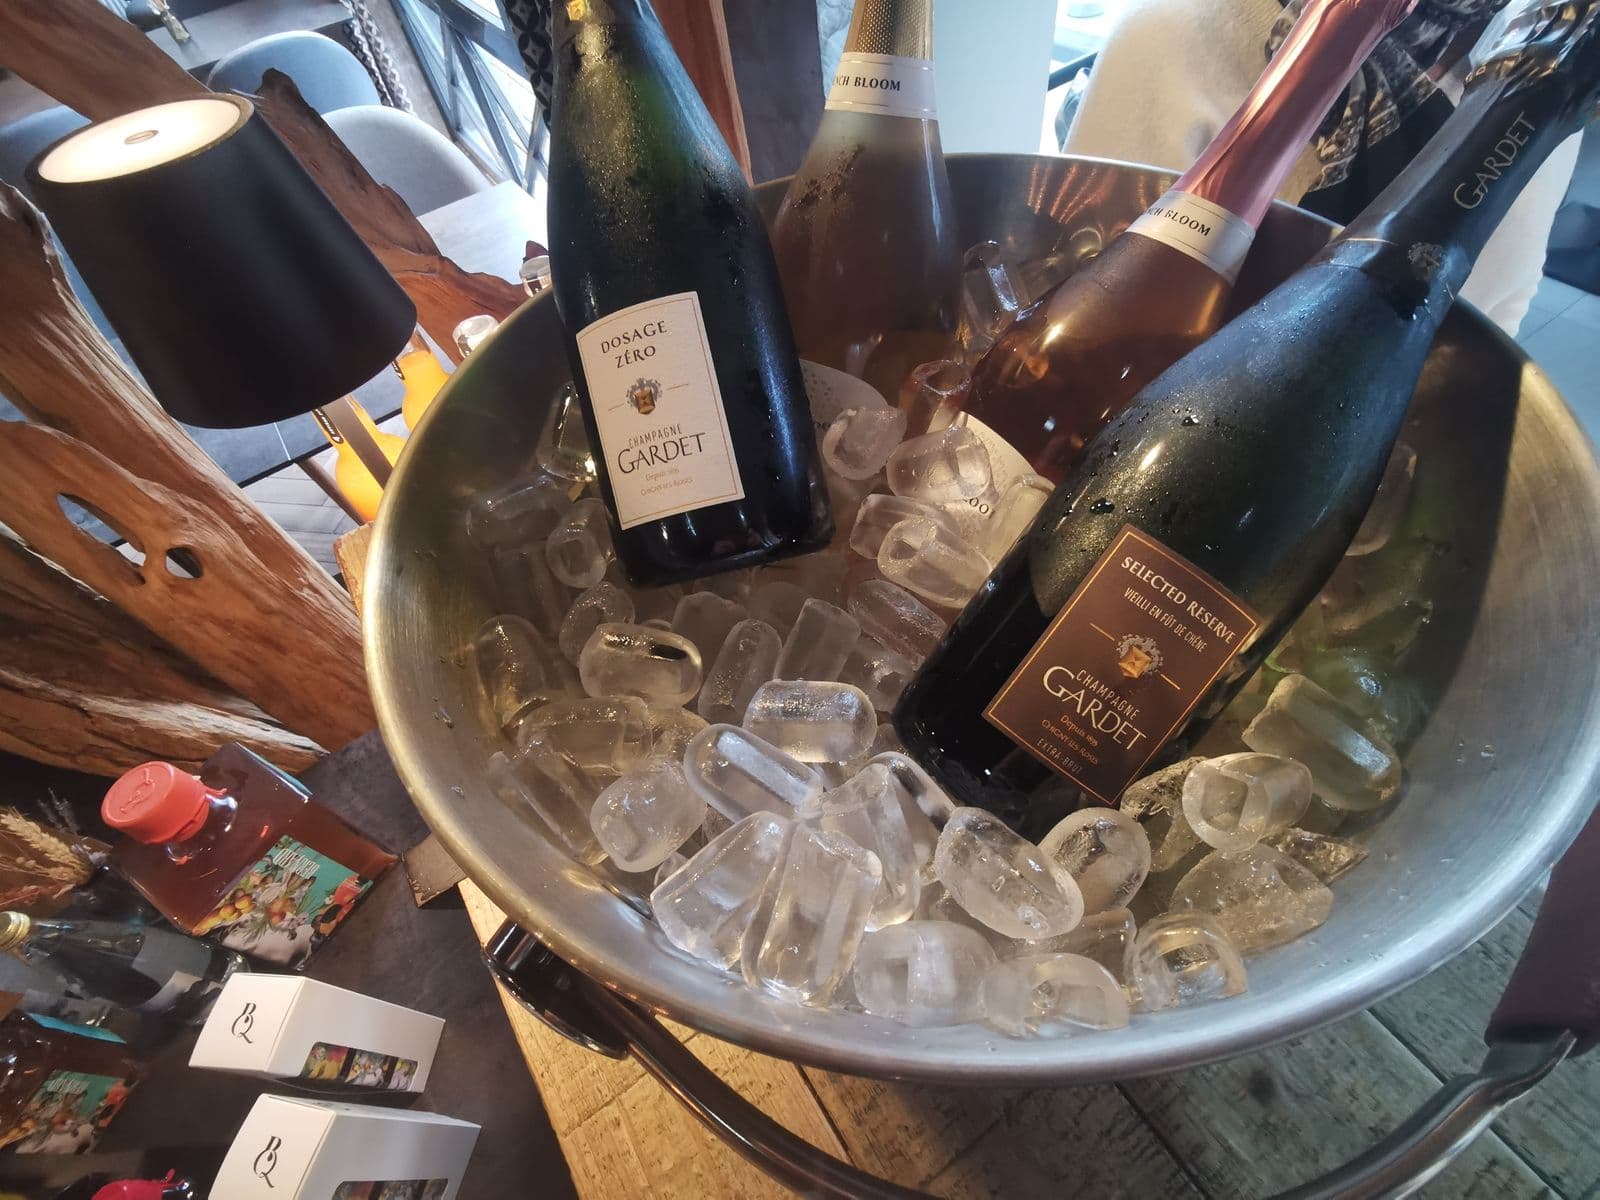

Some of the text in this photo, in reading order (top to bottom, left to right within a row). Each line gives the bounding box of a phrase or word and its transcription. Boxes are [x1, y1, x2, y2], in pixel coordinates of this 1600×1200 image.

[854, 77, 901, 92] BLOOM
[1453, 111, 1536, 210] GARDET
[1165, 209, 1211, 236] BLOOM
[600, 320, 668, 354] DOSAGE
[615, 345, 656, 369] ZÉRO
[617, 432, 706, 474] GARDET
[629, 423, 683, 449] CHAMPAGNE
[1120, 556, 1237, 645] SELECTED RESERVE
[1124, 587, 1150, 611] VIEILLI
[1149, 605, 1163, 619] EN
[1160, 614, 1176, 629] FÛT
[1175, 625, 1187, 637] DE
[1042, 665, 1147, 750] GARDET
[1075, 669, 1140, 721] CHAMPAGNE
[1060, 714, 1084, 737] Depuis
